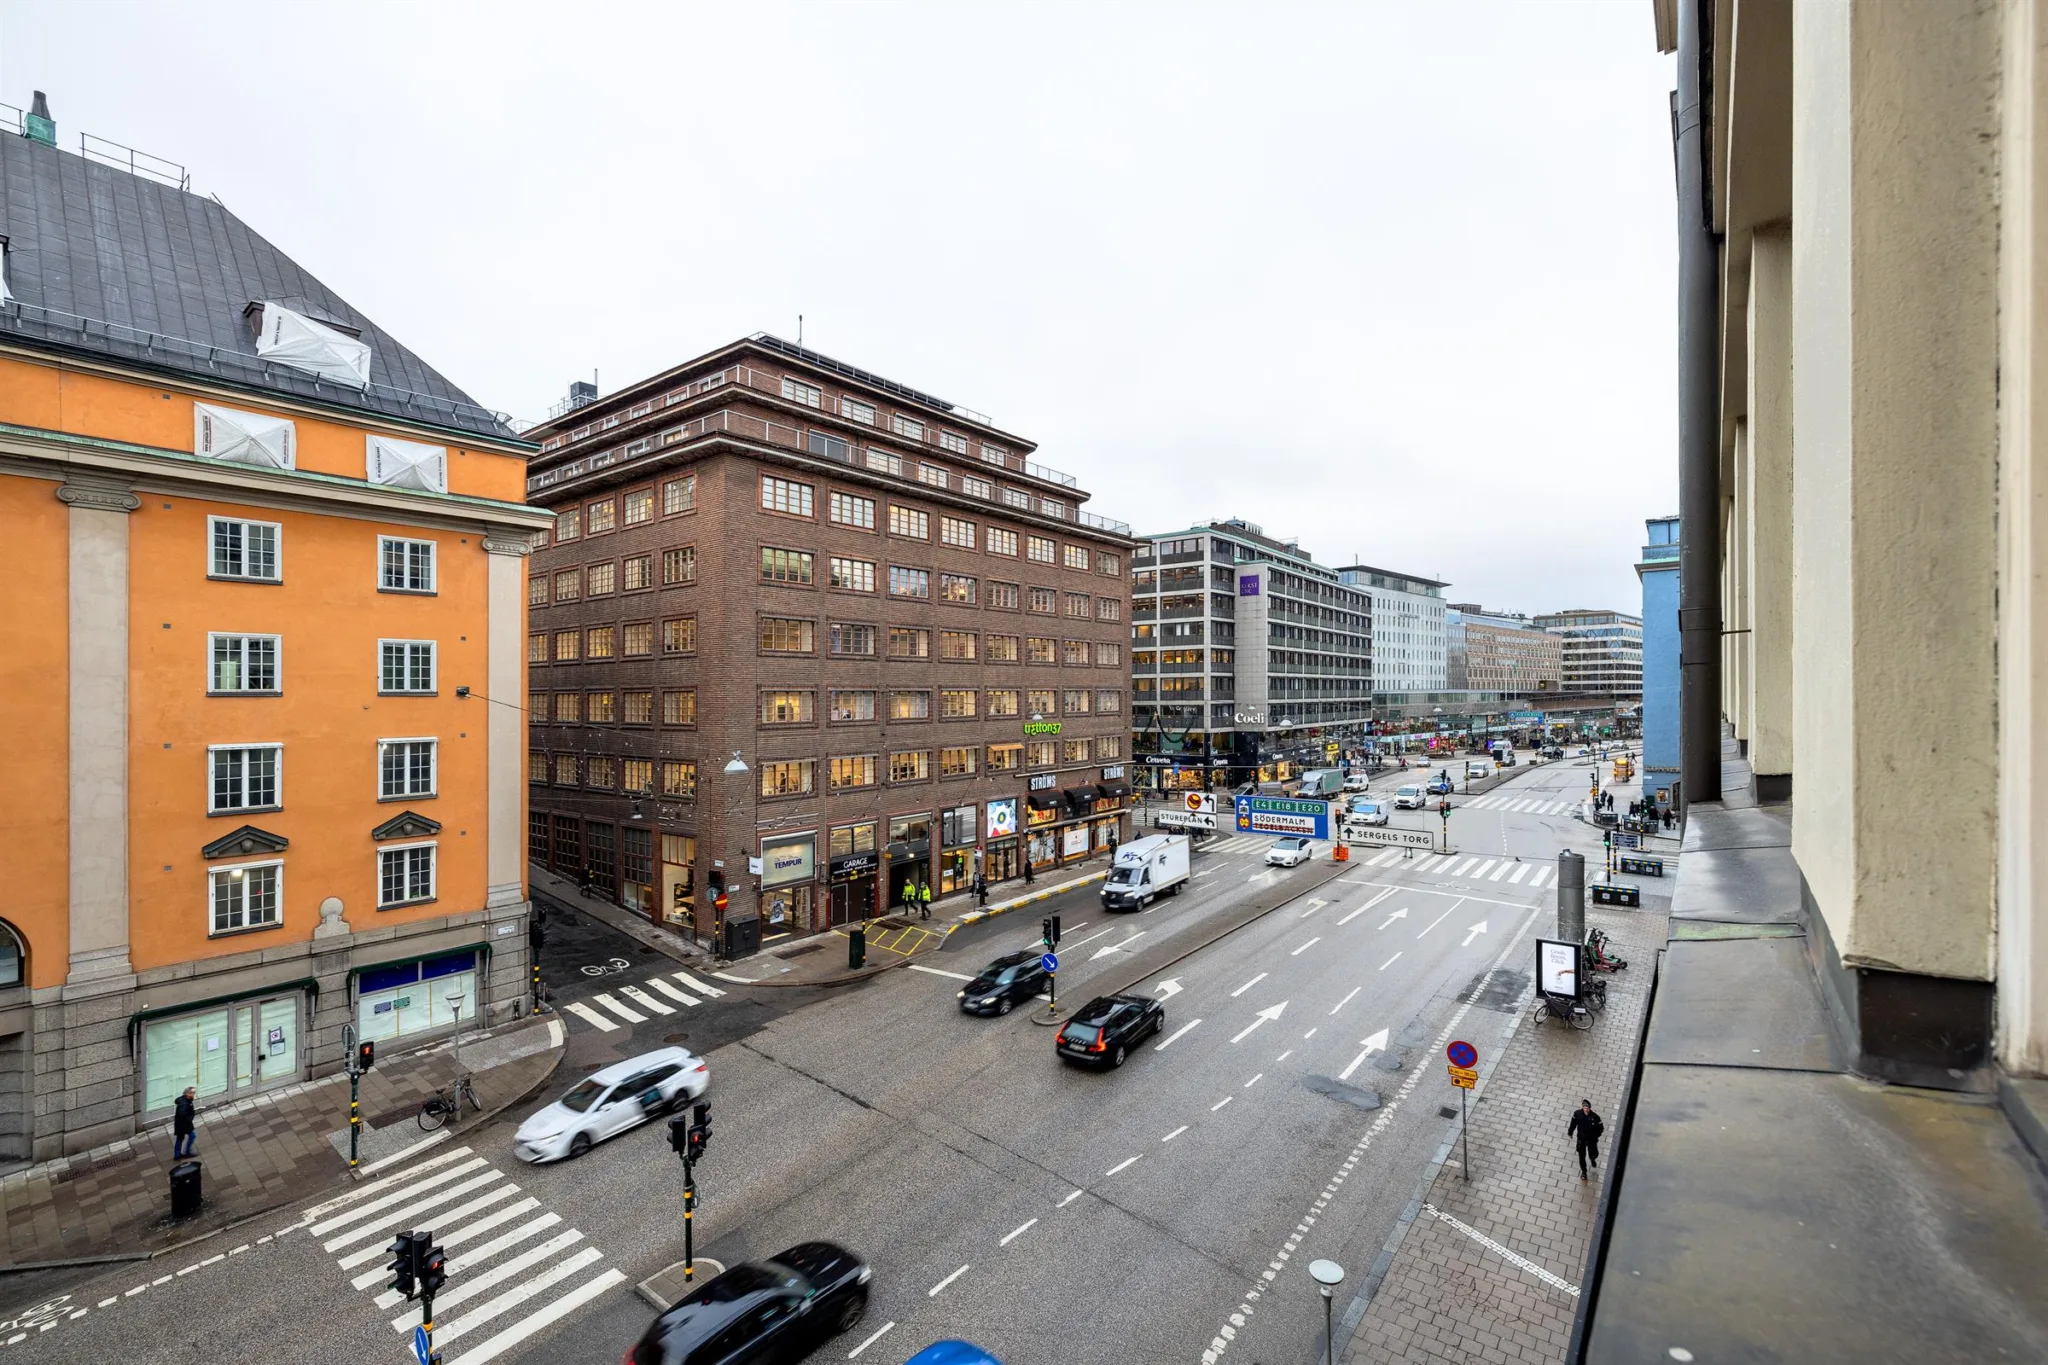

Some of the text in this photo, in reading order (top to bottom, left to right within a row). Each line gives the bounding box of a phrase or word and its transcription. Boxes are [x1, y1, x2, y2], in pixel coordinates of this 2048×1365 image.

[1234, 712, 1265, 724] Coeli
[1104, 764, 1125, 780] STRÖMS
[1030, 774, 1057, 791] STRÖMS
[1255, 800, 1321, 812] E4 E18 E20
[1160, 813, 1204, 824] STUREPLAN
[1254, 814, 1306, 826] SÖDERMALM
[1357, 830, 1430, 844] SERGELS TORG
[774, 858, 802, 869] TEMPUR
[843, 857, 868, 869] GARAGE
